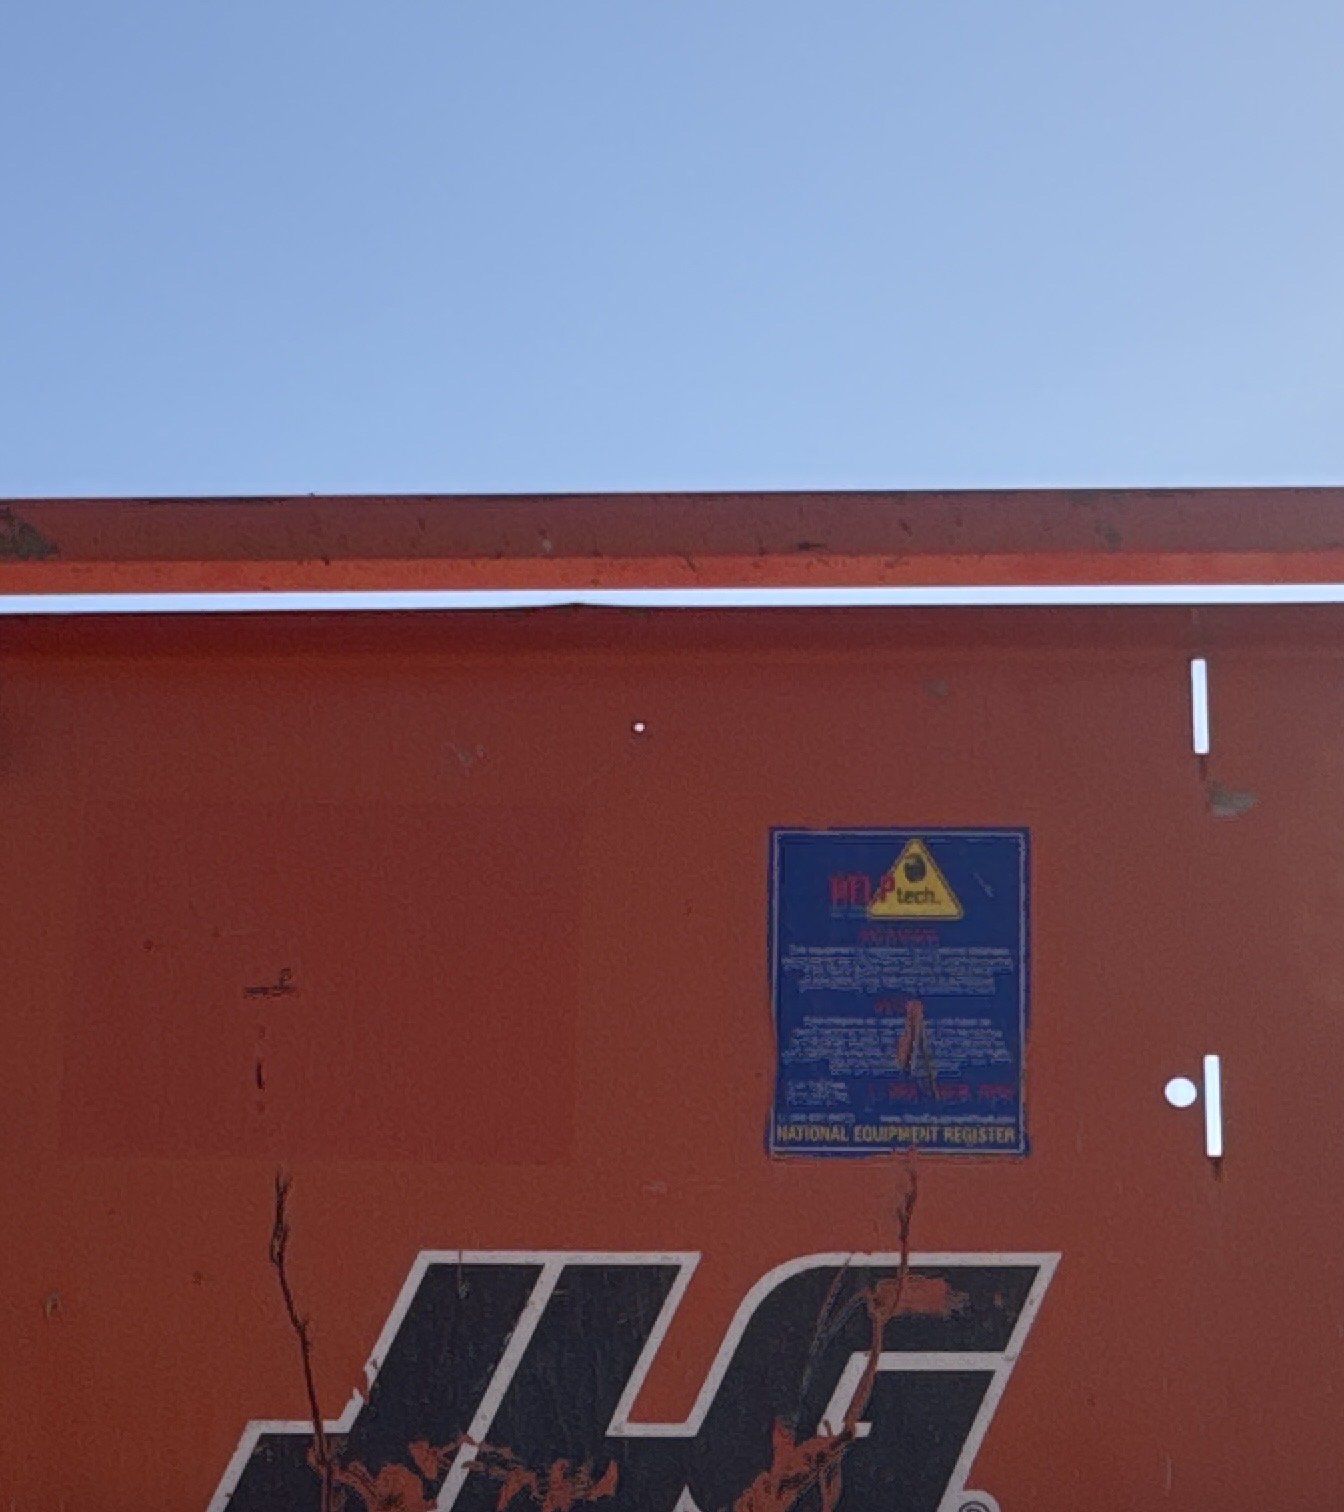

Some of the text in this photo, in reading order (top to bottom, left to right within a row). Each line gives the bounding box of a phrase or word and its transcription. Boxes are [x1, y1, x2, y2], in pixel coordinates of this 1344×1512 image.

[776, 1123, 1016, 1144] NATIONAL EQUIPMENT REGISTER
